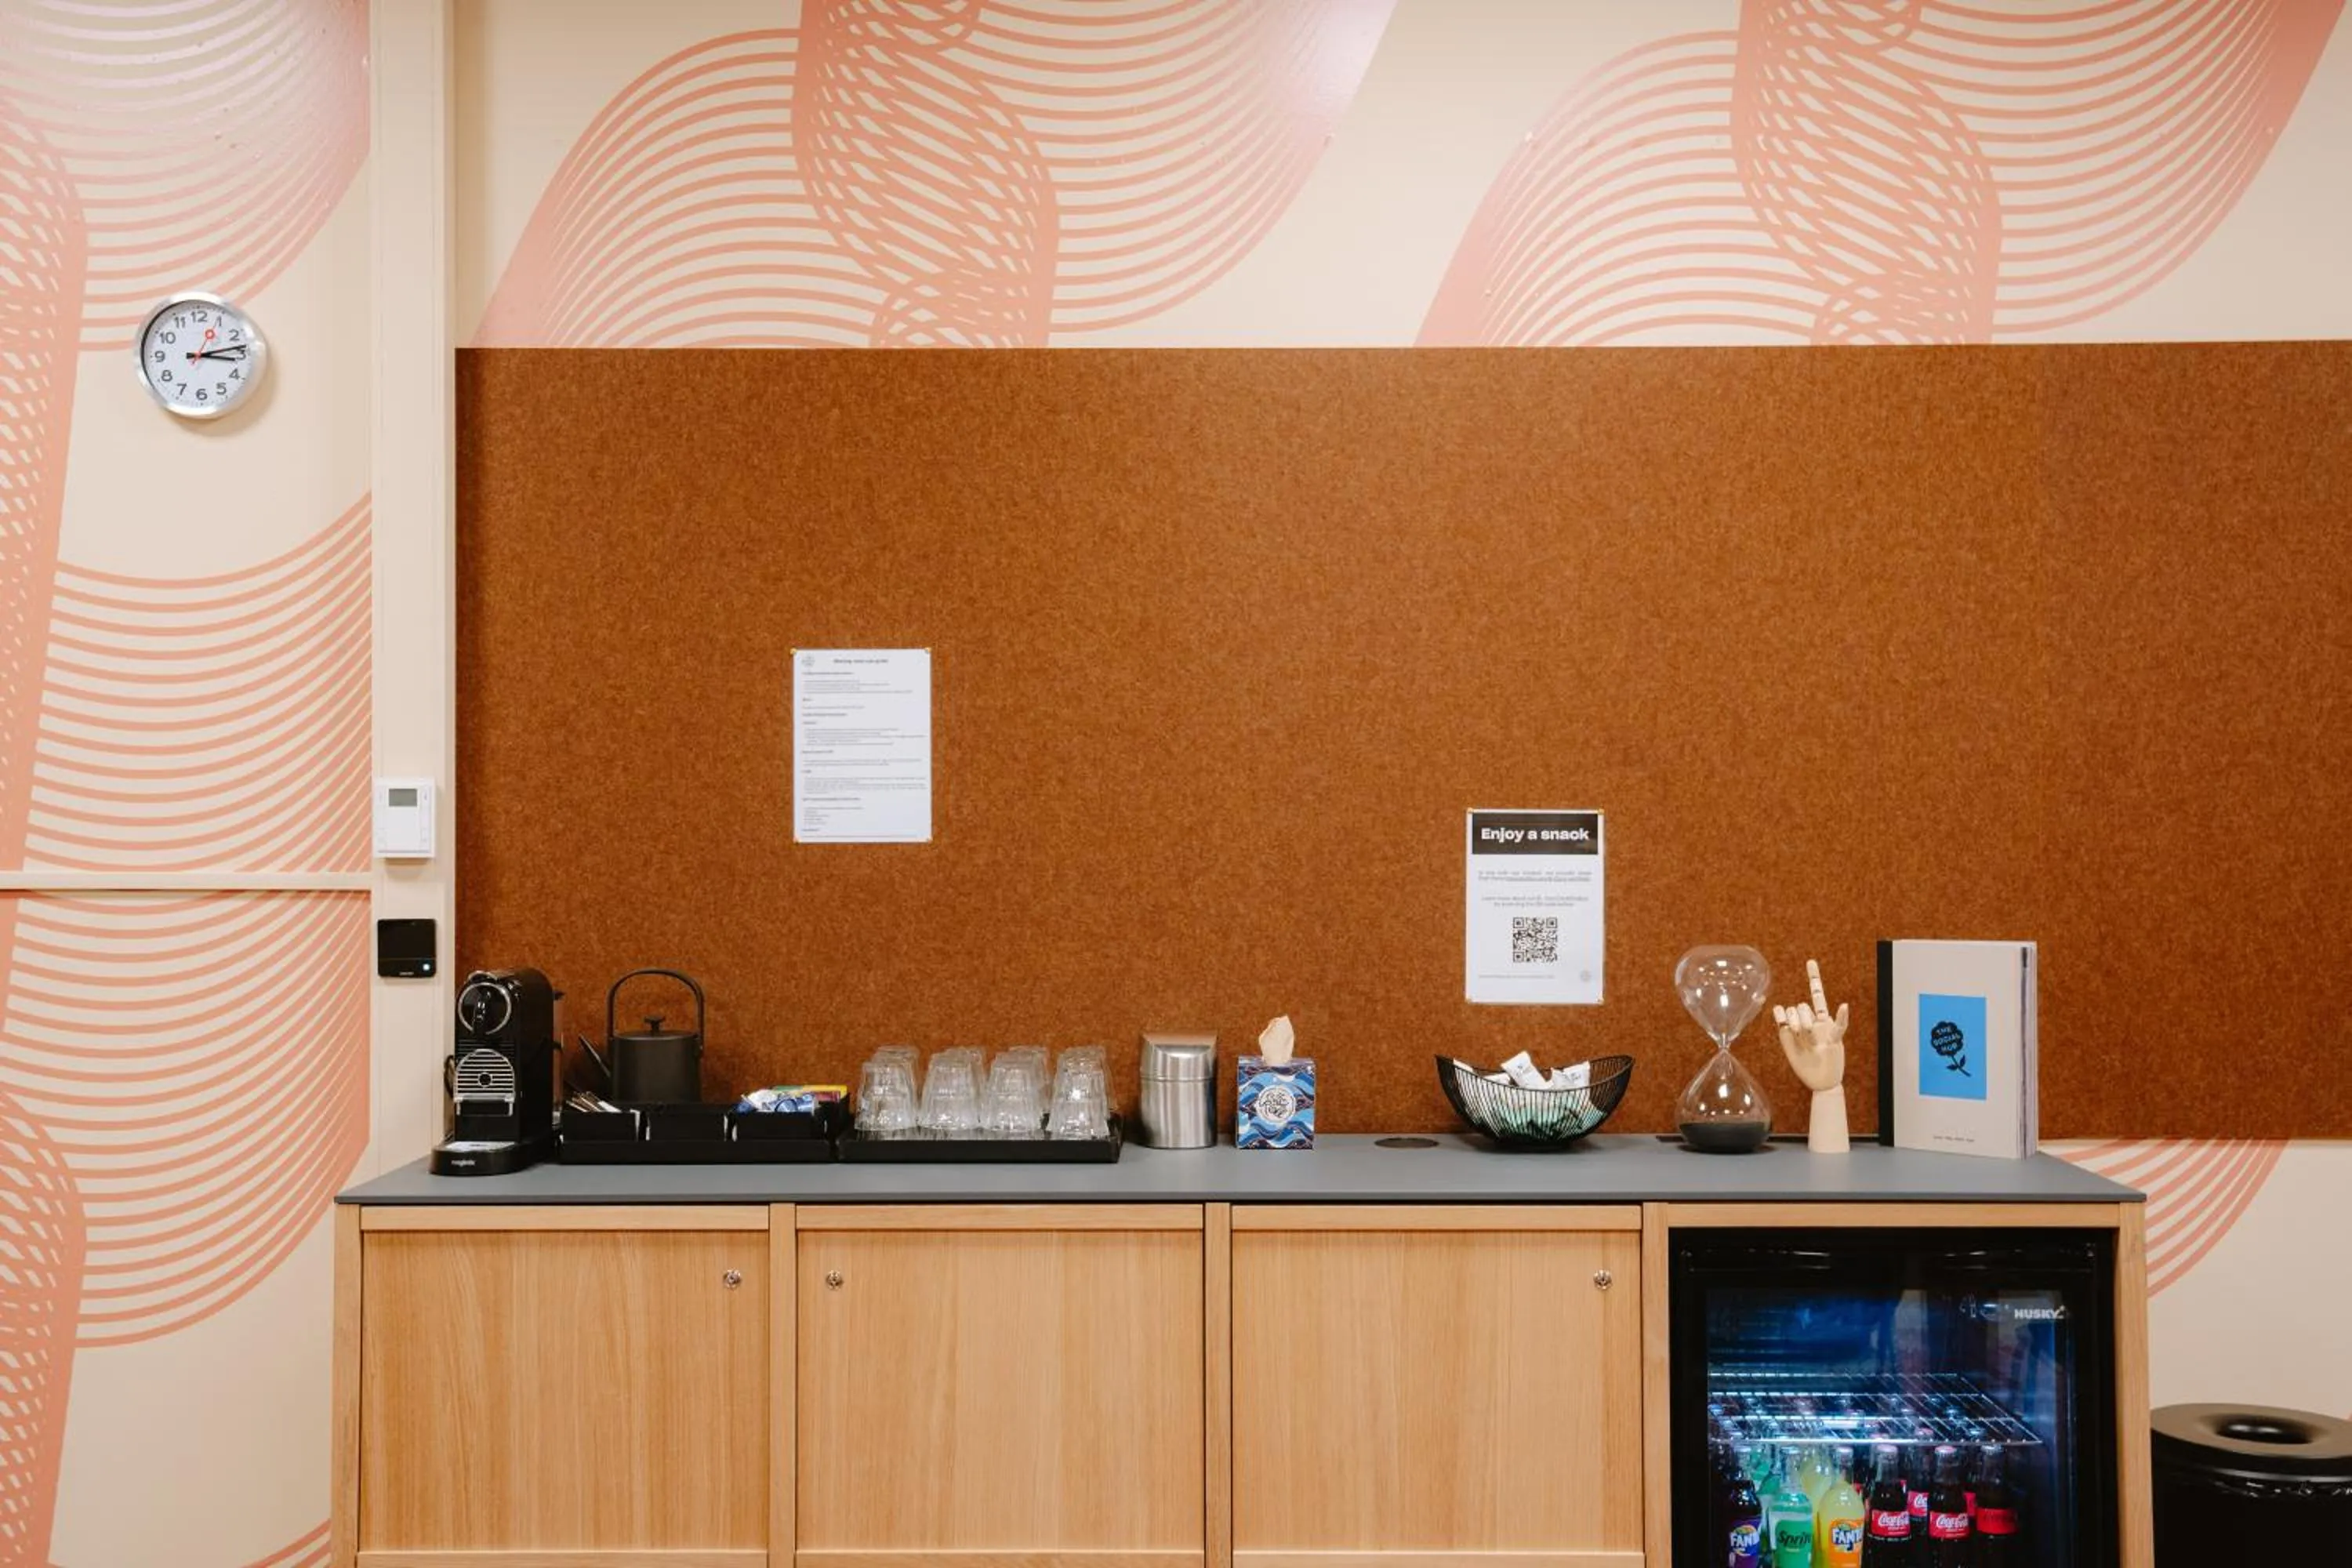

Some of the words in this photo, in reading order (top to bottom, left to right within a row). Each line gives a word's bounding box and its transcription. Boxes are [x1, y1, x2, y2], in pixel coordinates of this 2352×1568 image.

[174, 316, 186, 328] 11
[191, 310, 208, 323] 12
[216, 315, 223, 327] 1
[159, 332, 176, 344] 10
[228, 329, 240, 341] 2
[154, 350, 165, 362] 9
[236, 347, 246, 361] 3
[161, 369, 172, 382] 8
[228, 368, 240, 380] 4
[176, 383, 187, 396] 7
[196, 388, 208, 401] 6
[216, 383, 227, 395] 5
[1481, 827, 1524, 843] Enjoy
[1527, 830, 1537, 840] a
[1541, 828, 1590, 840] snack
[2014, 1306, 2063, 1319] HUSKY
